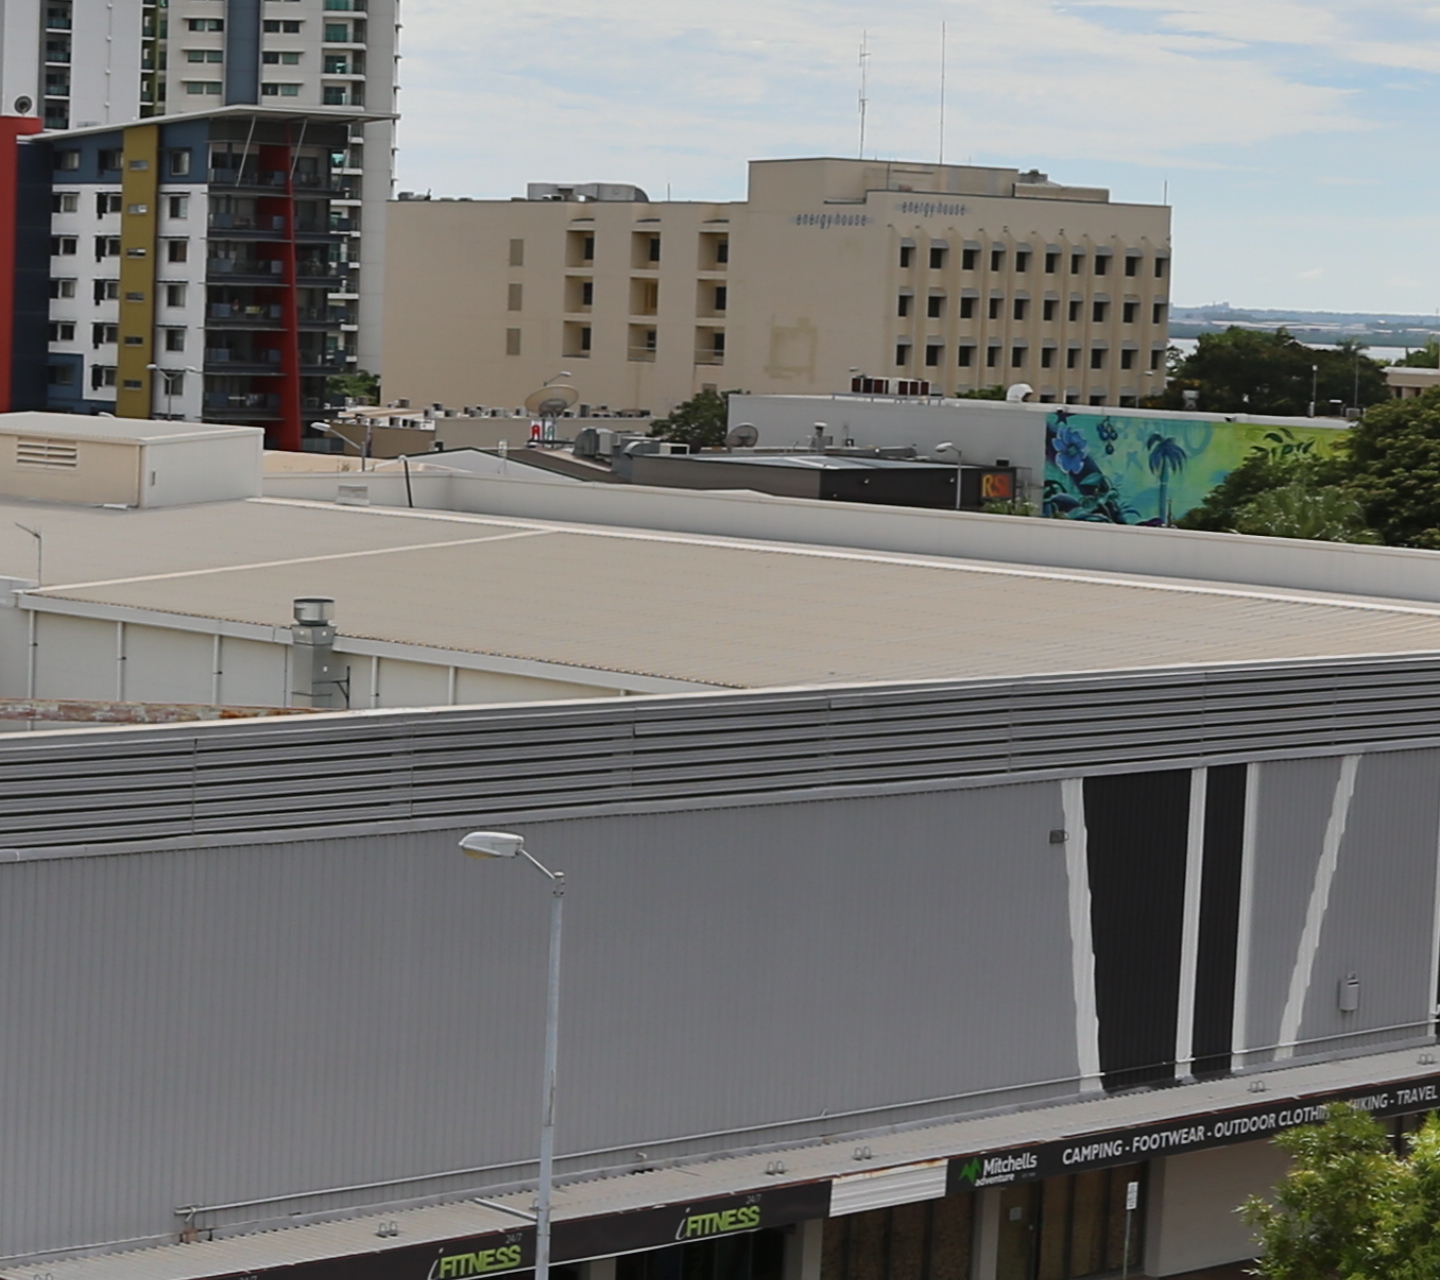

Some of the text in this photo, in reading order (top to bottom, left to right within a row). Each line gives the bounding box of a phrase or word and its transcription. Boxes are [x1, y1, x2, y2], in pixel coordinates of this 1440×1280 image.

[1062, 1140, 1123, 1165] CAMPING
[1132, 1125, 1205, 1153] FOOTWEAR
[1214, 1113, 1276, 1138] OUTDOOR
[1396, 1085, 1439, 1106] TRAVEL
[983, 1152, 1037, 1176] Mitchells
[975, 1173, 1015, 1187] adventure
